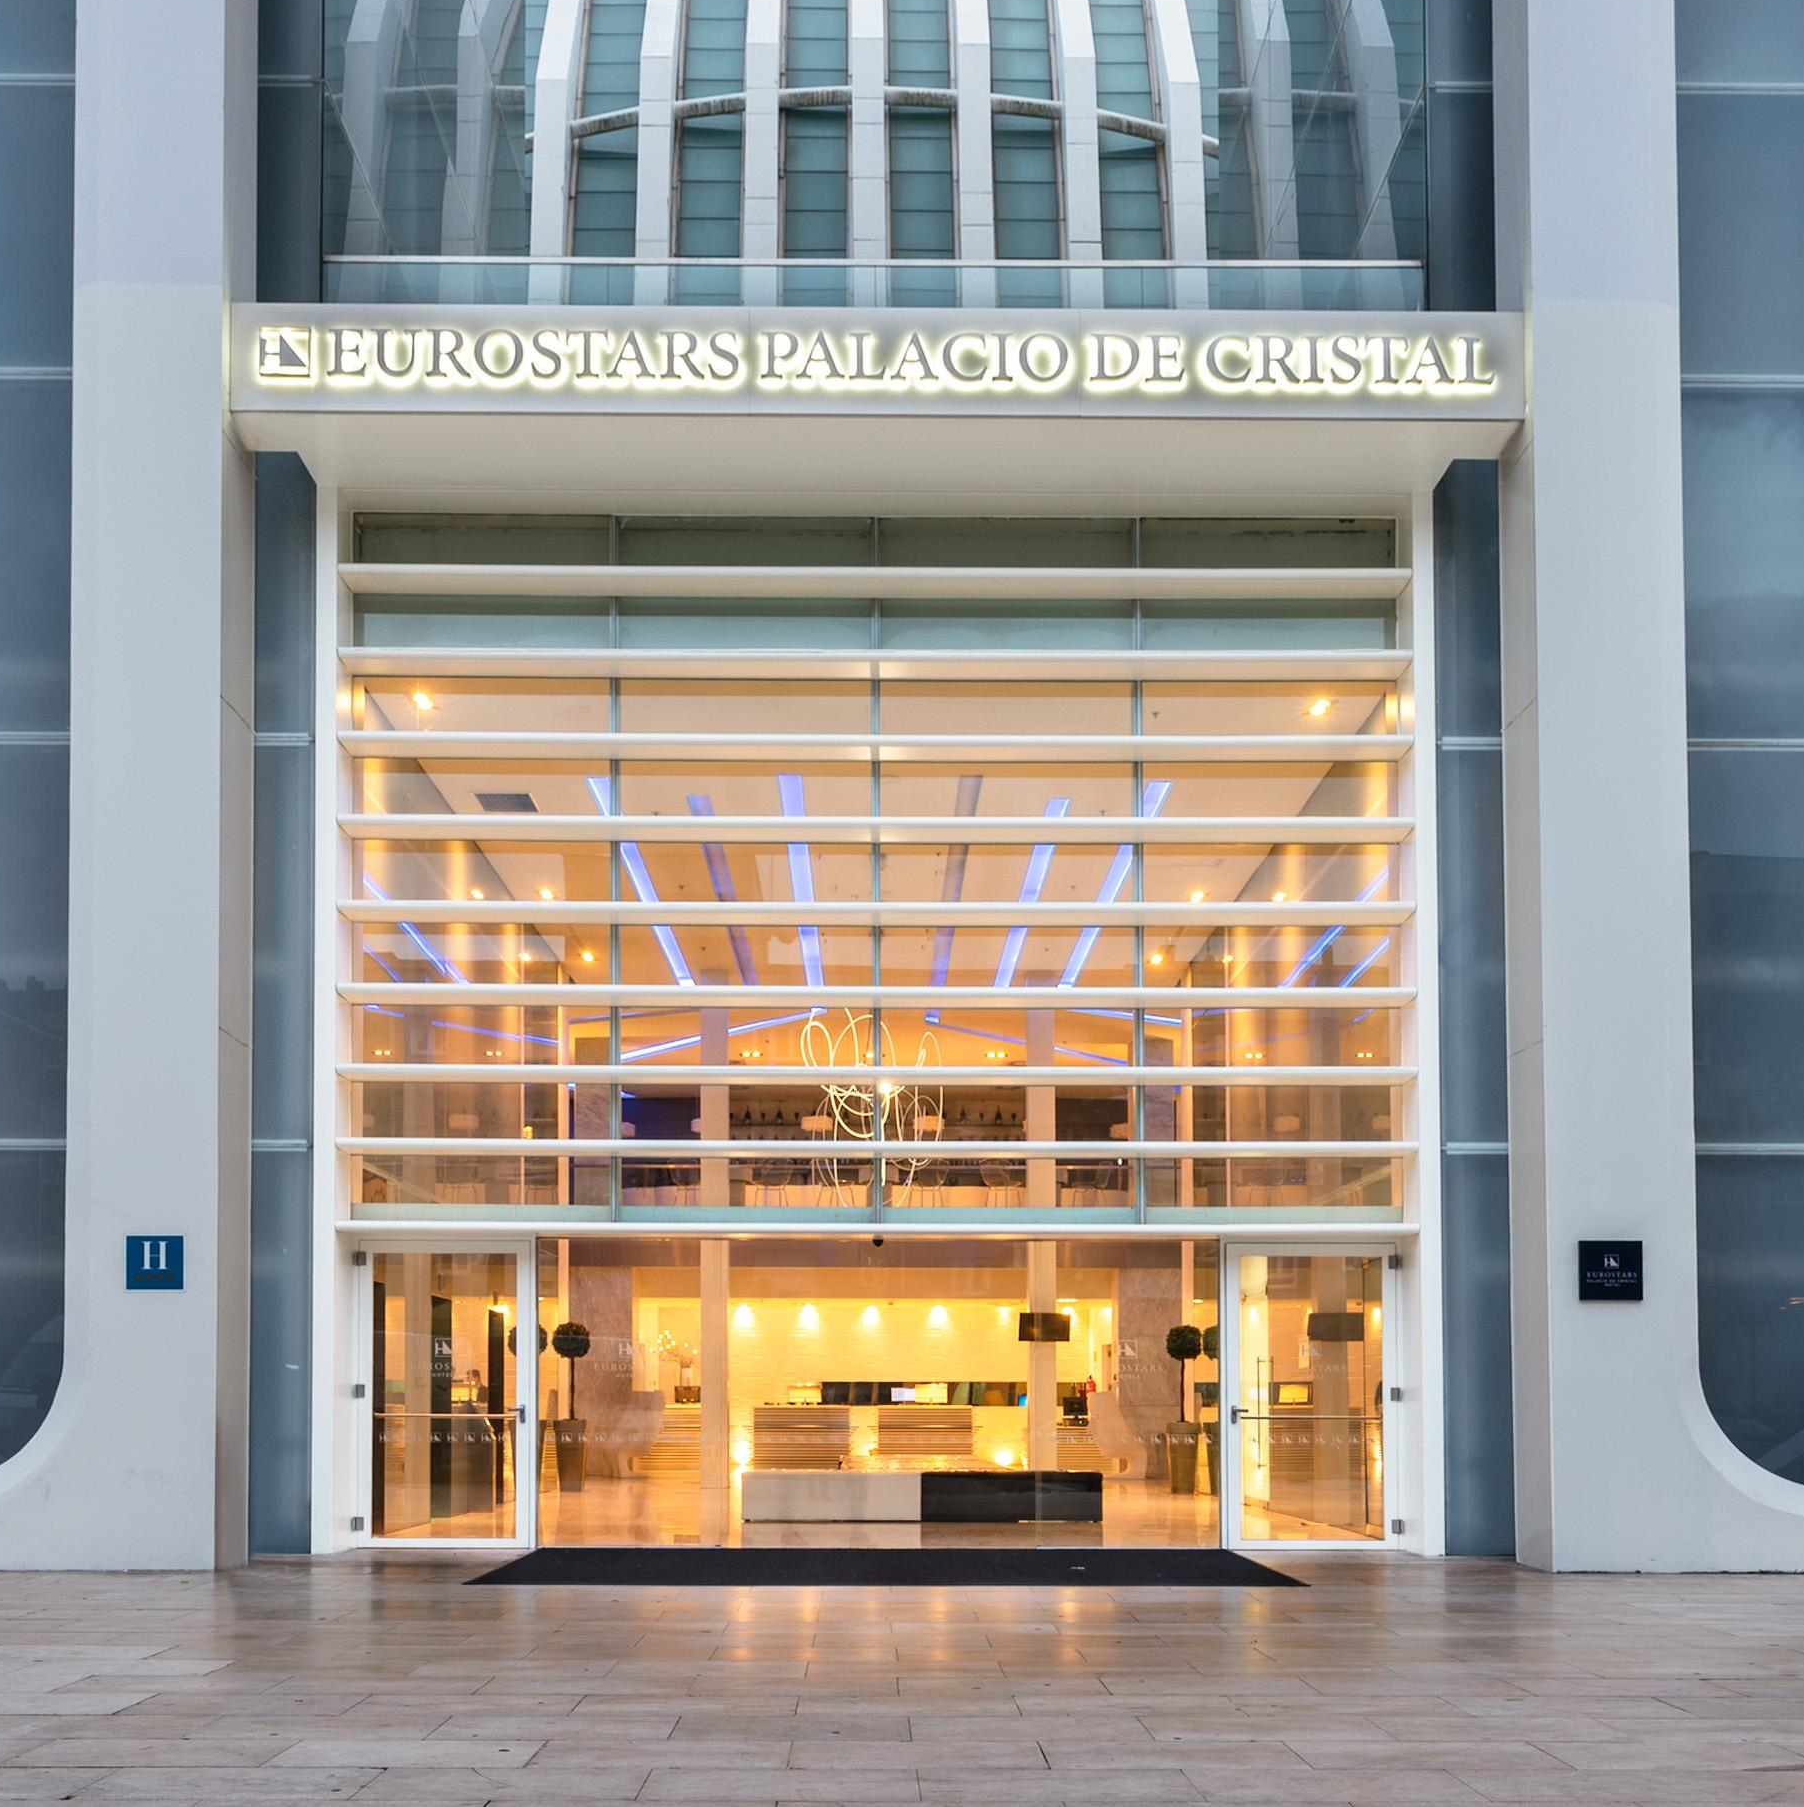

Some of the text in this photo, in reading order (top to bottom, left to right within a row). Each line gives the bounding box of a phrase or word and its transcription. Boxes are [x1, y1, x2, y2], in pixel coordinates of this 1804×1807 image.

[326, 327, 1496, 386] EUROSTARS PALACIO DE CRISTAL
[142, 1241, 168, 1270] H
